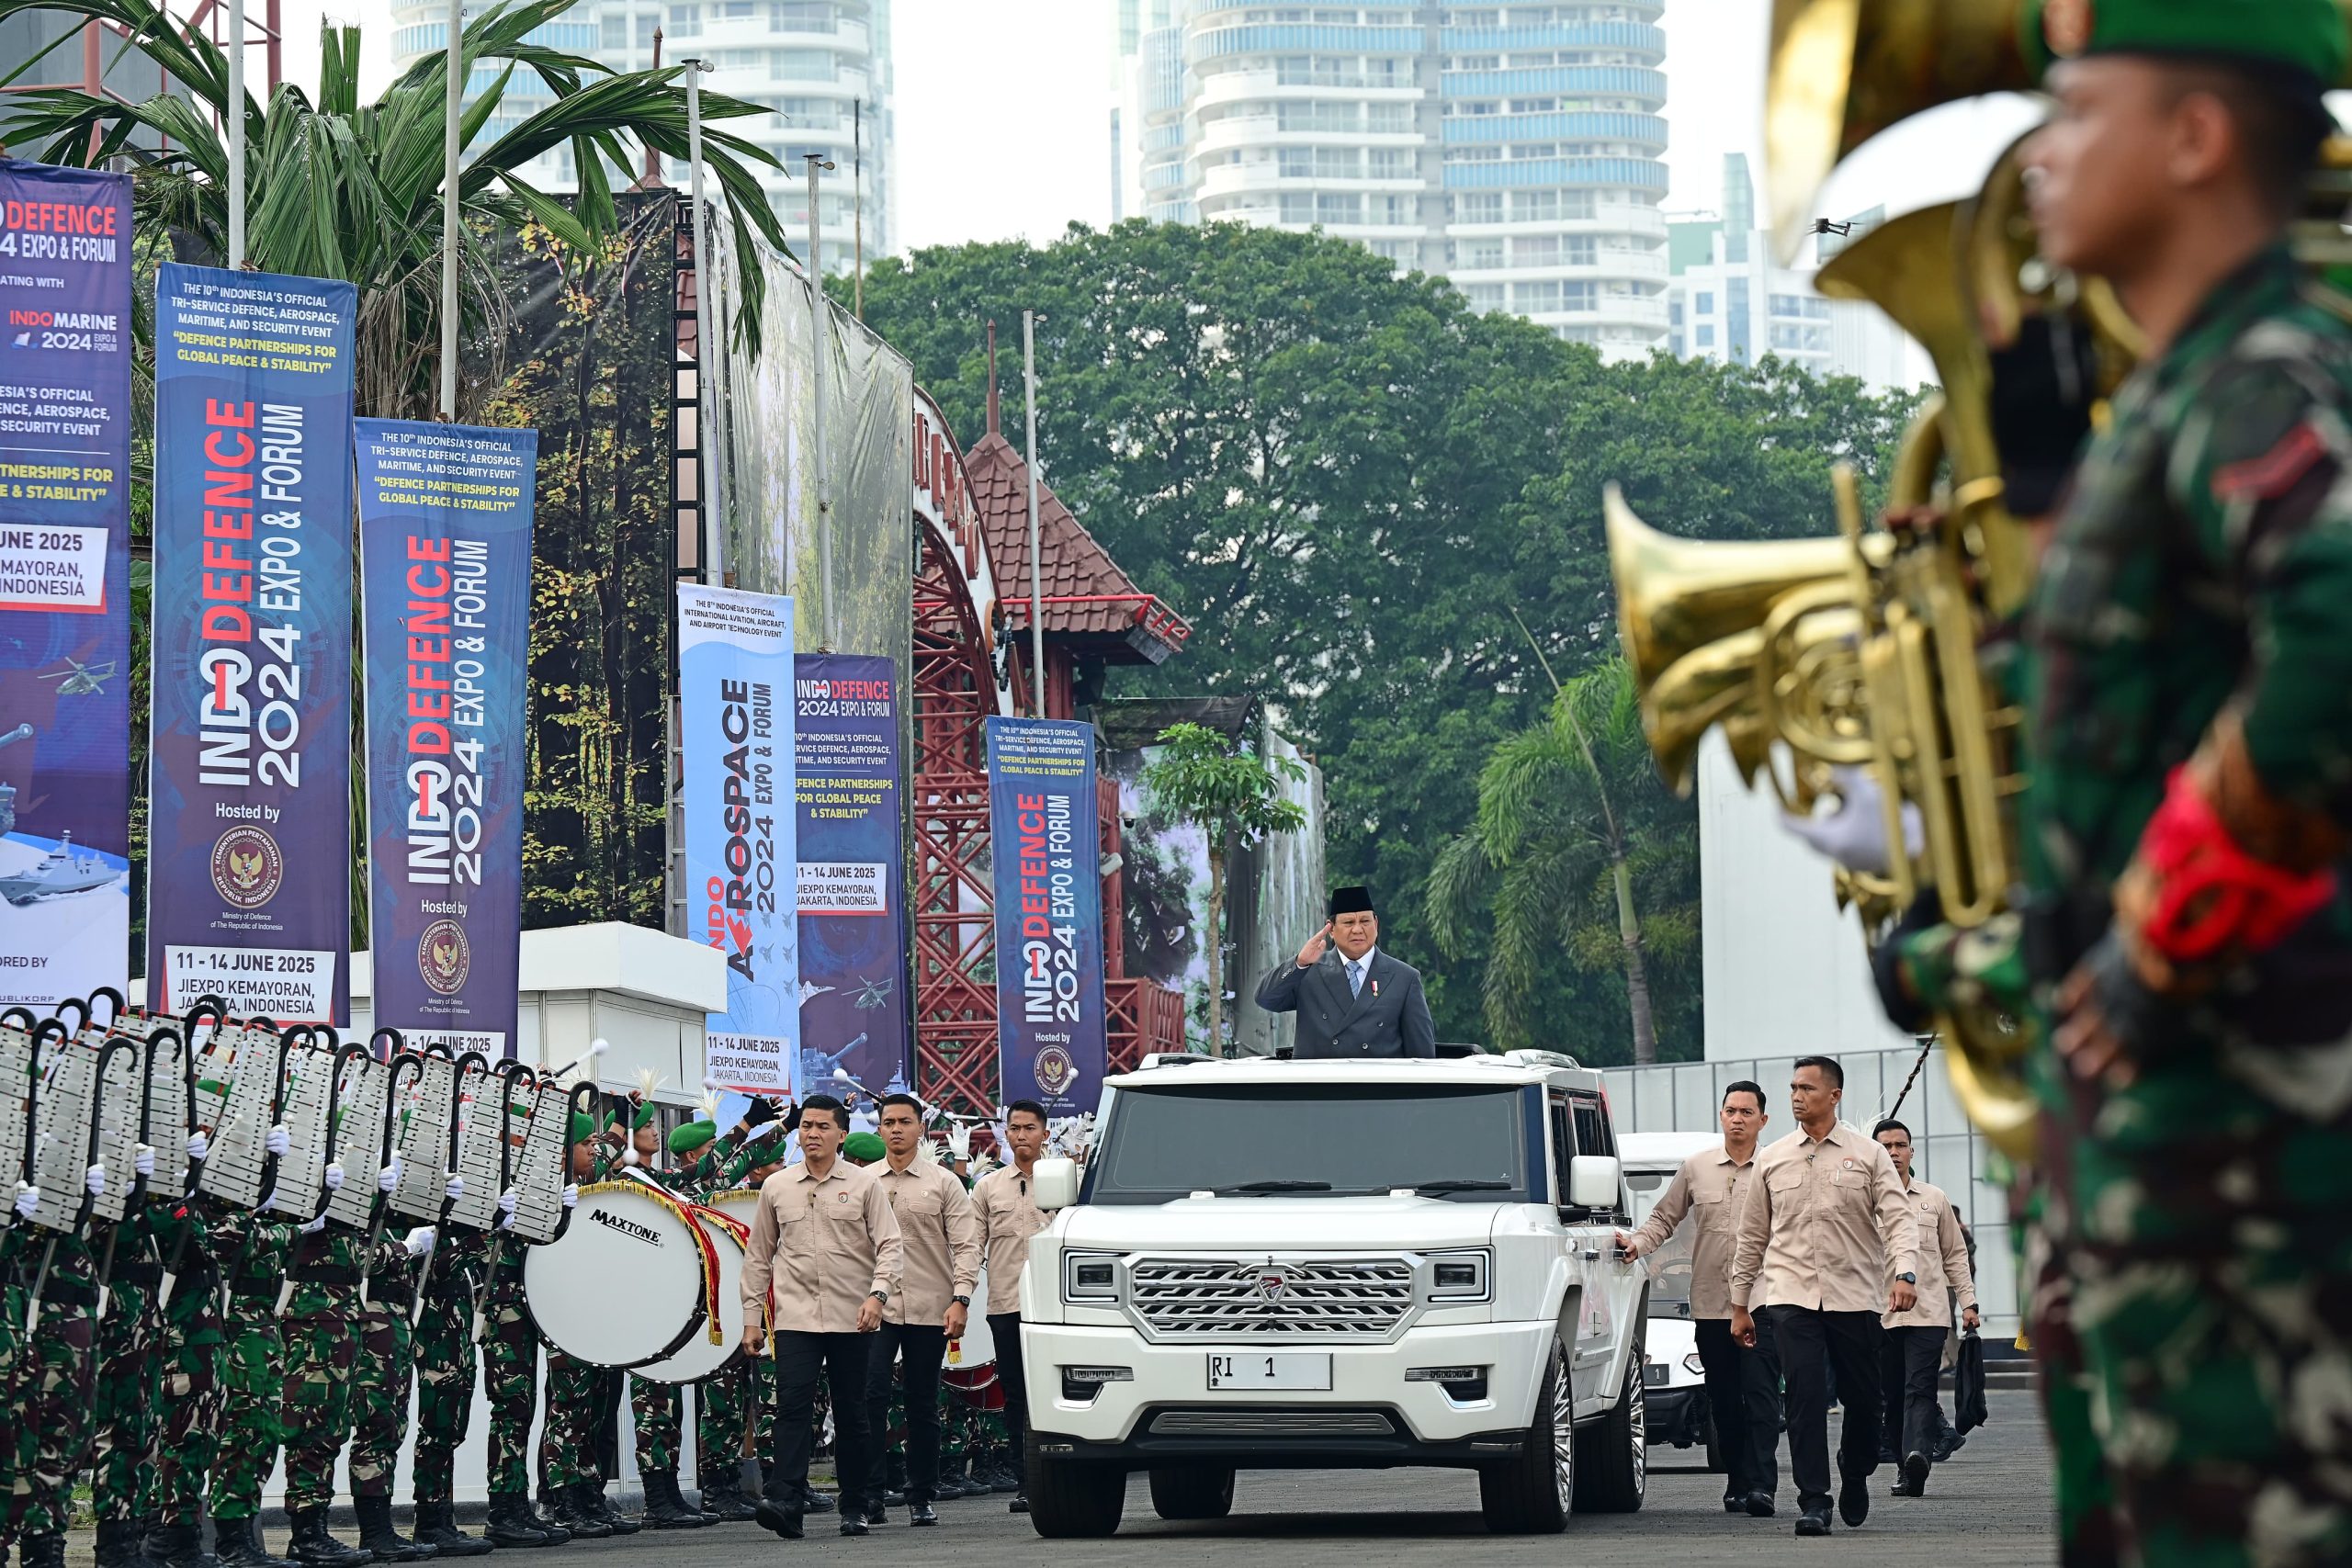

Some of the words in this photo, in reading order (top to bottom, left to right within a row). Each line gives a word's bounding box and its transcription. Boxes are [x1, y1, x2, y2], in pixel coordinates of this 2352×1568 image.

[22, 233, 57, 259] EXPO
[60, 236, 69, 260] &
[72, 236, 117, 263] FORUM
[36, 276, 64, 288] WITH
[184, 283, 200, 294] THE
[285, 293, 327, 307] OFFICIAL
[172, 297, 230, 312] TRI-SERVICE
[232, 303, 277, 320] DEFENCE,
[279, 308, 340, 325] AEROSPACE,
[178, 313, 227, 330] MARITIME,
[230, 318, 250, 330] AND
[252, 320, 299, 334] SECURITY
[302, 325, 332, 337] EVENT
[41, 332, 93, 351] 2024
[94, 333, 110, 343] EXPO
[230, 336, 311, 355] PARTNERSHIPS
[314, 344, 336, 357] FOR
[94, 343, 118, 352] FORUM
[177, 348, 219, 364] GLOBAL
[222, 353, 257, 367] PEACE
[261, 356, 268, 368] &
[40, 388, 94, 402] OFFICIAL
[35, 405, 110, 422] AEROSPACE,
[1, 419, 61, 434] SECURITY
[62, 422, 101, 436] EVENT
[382, 432, 398, 443] THE
[474, 440, 511, 452] OFFICIAL
[262, 402, 304, 503] FORUM
[371, 446, 426, 458] TRI-SERVICE
[428, 450, 469, 463] DEFENCE,
[470, 454, 523, 468] AEROSPACE,
[83, 468, 113, 482] FOR
[379, 460, 424, 475] MARITIME,
[426, 464, 446, 474] AND
[447, 466, 488, 477] SECURITY
[490, 468, 515, 479] EVENT
[12, 484, 22, 498] &
[427, 480, 497, 495] PARTNERSHIPS
[500, 486, 519, 497] FOR
[379, 492, 418, 505] GLOBAL
[421, 495, 450, 507] PEACE
[454, 498, 458, 508] &
[261, 511, 302, 529] &
[39, 533, 84, 552] 2025
[259, 537, 301, 612] EXPO
[453, 539, 488, 628] FORUM
[696, 600, 706, 608] THE
[751, 607, 775, 616] OFFICIAL
[684, 609, 729, 621] INTERNATIONAL
[757, 618, 786, 630] AIRCRAFT,
[704, 622, 726, 630] AIRPORT
[764, 629, 782, 637] EVENT
[454, 636, 486, 653] &
[453, 660, 485, 728] EXPO
[257, 623, 301, 788] 2024
[752, 682, 772, 739] FORUM
[798, 700, 840, 716] 2024
[841, 701, 860, 717] EXPO
[861, 701, 866, 716] &
[867, 701, 890, 717] FORUM
[853, 734, 883, 743] OFFICIAL
[753, 745, 773, 757] &
[818, 745, 850, 755] DEFENCE,
[851, 746, 891, 756] AEROSPACE,
[817, 756, 832, 764] AND
[833, 757, 866, 765] SECURITY
[866, 757, 887, 765] EVENT
[1028, 756, 1071, 765] PARTNERSHIPS
[754, 763, 773, 805] EXPO
[828, 778, 893, 790] PARTNERSHIPS
[796, 793, 814, 804] FOR
[815, 793, 852, 805] GLOBAL
[853, 794, 882, 805] PEACE
[215, 802, 261, 819] Hosted
[264, 805, 280, 824] by
[454, 738, 484, 886] 2024
[810, 808, 818, 818] &
[1046, 795, 1072, 853] FORUM
[214, 829, 247, 865] KEMENTERIAN
[247, 829, 279, 868] PERTAHANAN
[755, 815, 775, 915] 2024
[1050, 857, 1074, 869] &
[814, 866, 826, 878] 14
[827, 866, 853, 878] JUNE
[854, 867, 876, 879] 2025
[216, 875, 243, 903] REPUBLIK
[244, 878, 277, 904] INDONESIA
[796, 884, 824, 895] JIEXPO
[826, 885, 876, 896] KEMAYORAN,
[1050, 872, 1075, 918] EXPO
[421, 898, 457, 914] Hosted
[458, 901, 468, 918] by
[796, 896, 834, 907] JAKARTA,
[835, 896, 878, 906] INDONESIA
[31, 957, 49, 968] BY
[176, 952, 194, 969] 11
[209, 953, 228, 970] 14
[231, 954, 274, 972] JUNE
[277, 955, 315, 974] 2025
[1053, 924, 1080, 1022] 2024
[178, 978, 225, 994] JIEXPO
[228, 980, 315, 999] KEMAYORAN,
[243, 998, 315, 1014] INDONESIA
[467, 1037, 491, 1053] 2025
[707, 1036, 718, 1049] 11
[725, 1037, 736, 1050] 14
[737, 1038, 759, 1053] JUNE
[760, 1040, 780, 1054] 2025
[1035, 1032, 1060, 1042] Hosted
[1061, 1032, 1070, 1044] by
[709, 1055, 734, 1067] JIEXPO
[735, 1057, 781, 1073] KEMAYORAN,
[713, 1069, 743, 1082] JAKARTA,
[744, 1071, 778, 1084] INDONESIA
[589, 1208, 662, 1243] MAXTONE
[1212, 1357, 1233, 1377] RI
[1264, 1357, 1275, 1376] 1
